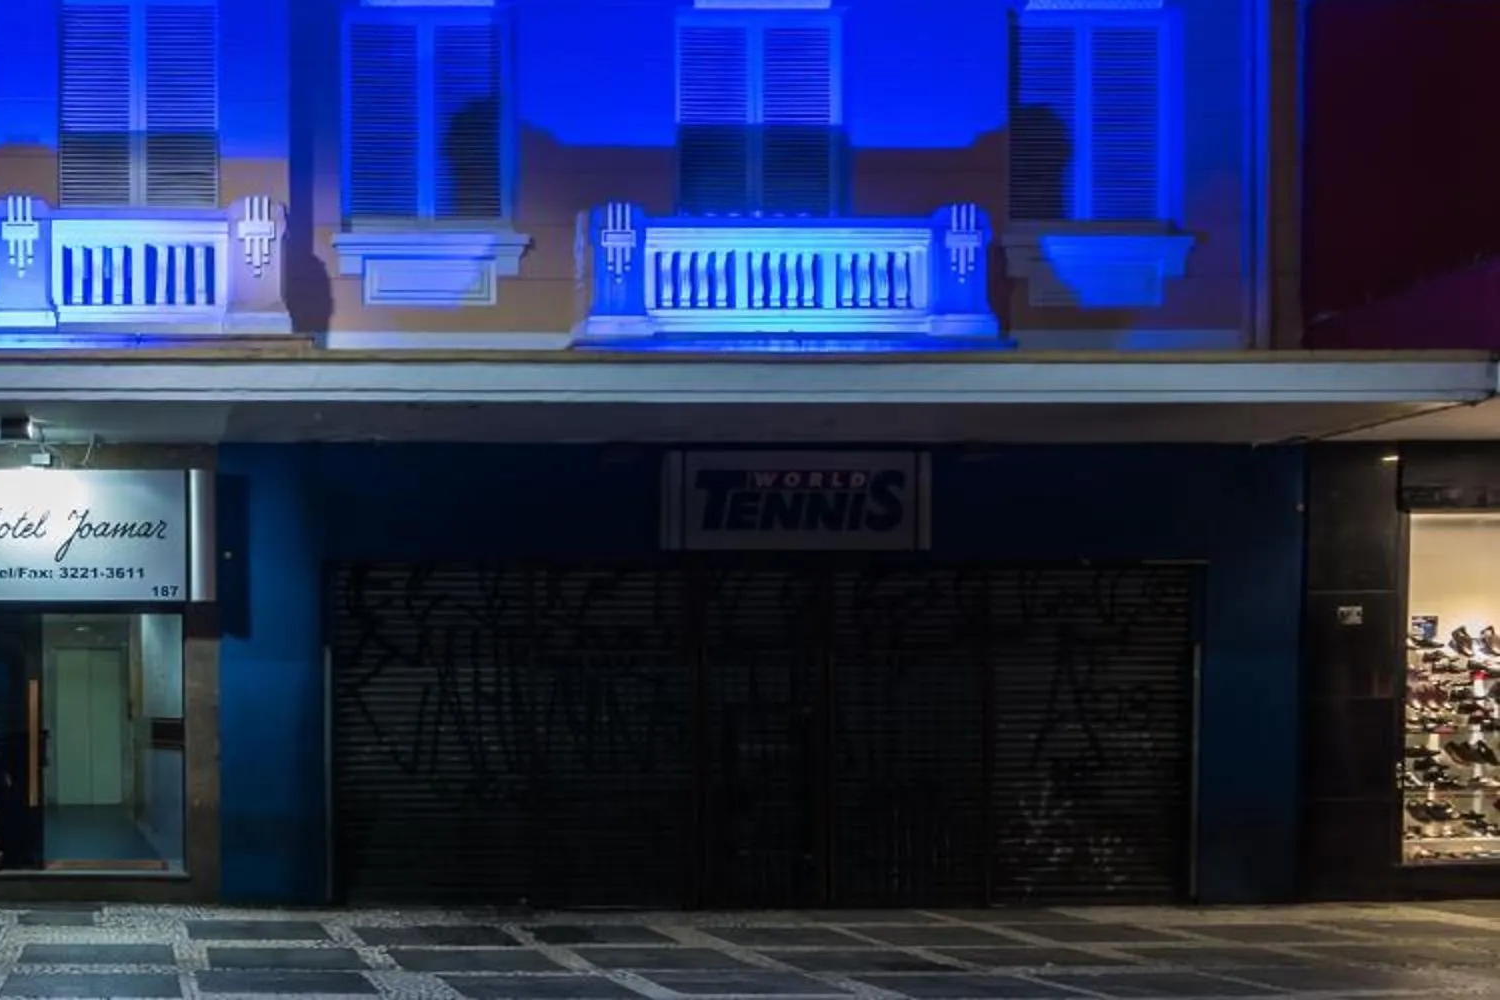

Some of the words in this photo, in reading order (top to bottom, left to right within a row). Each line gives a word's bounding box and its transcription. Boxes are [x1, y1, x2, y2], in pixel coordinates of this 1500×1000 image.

[754, 471, 866, 488] WORLD
[695, 470, 903, 530] TENNIS
[54, 508, 168, 562] Joamar
[59, 566, 145, 579] 3221-3611
